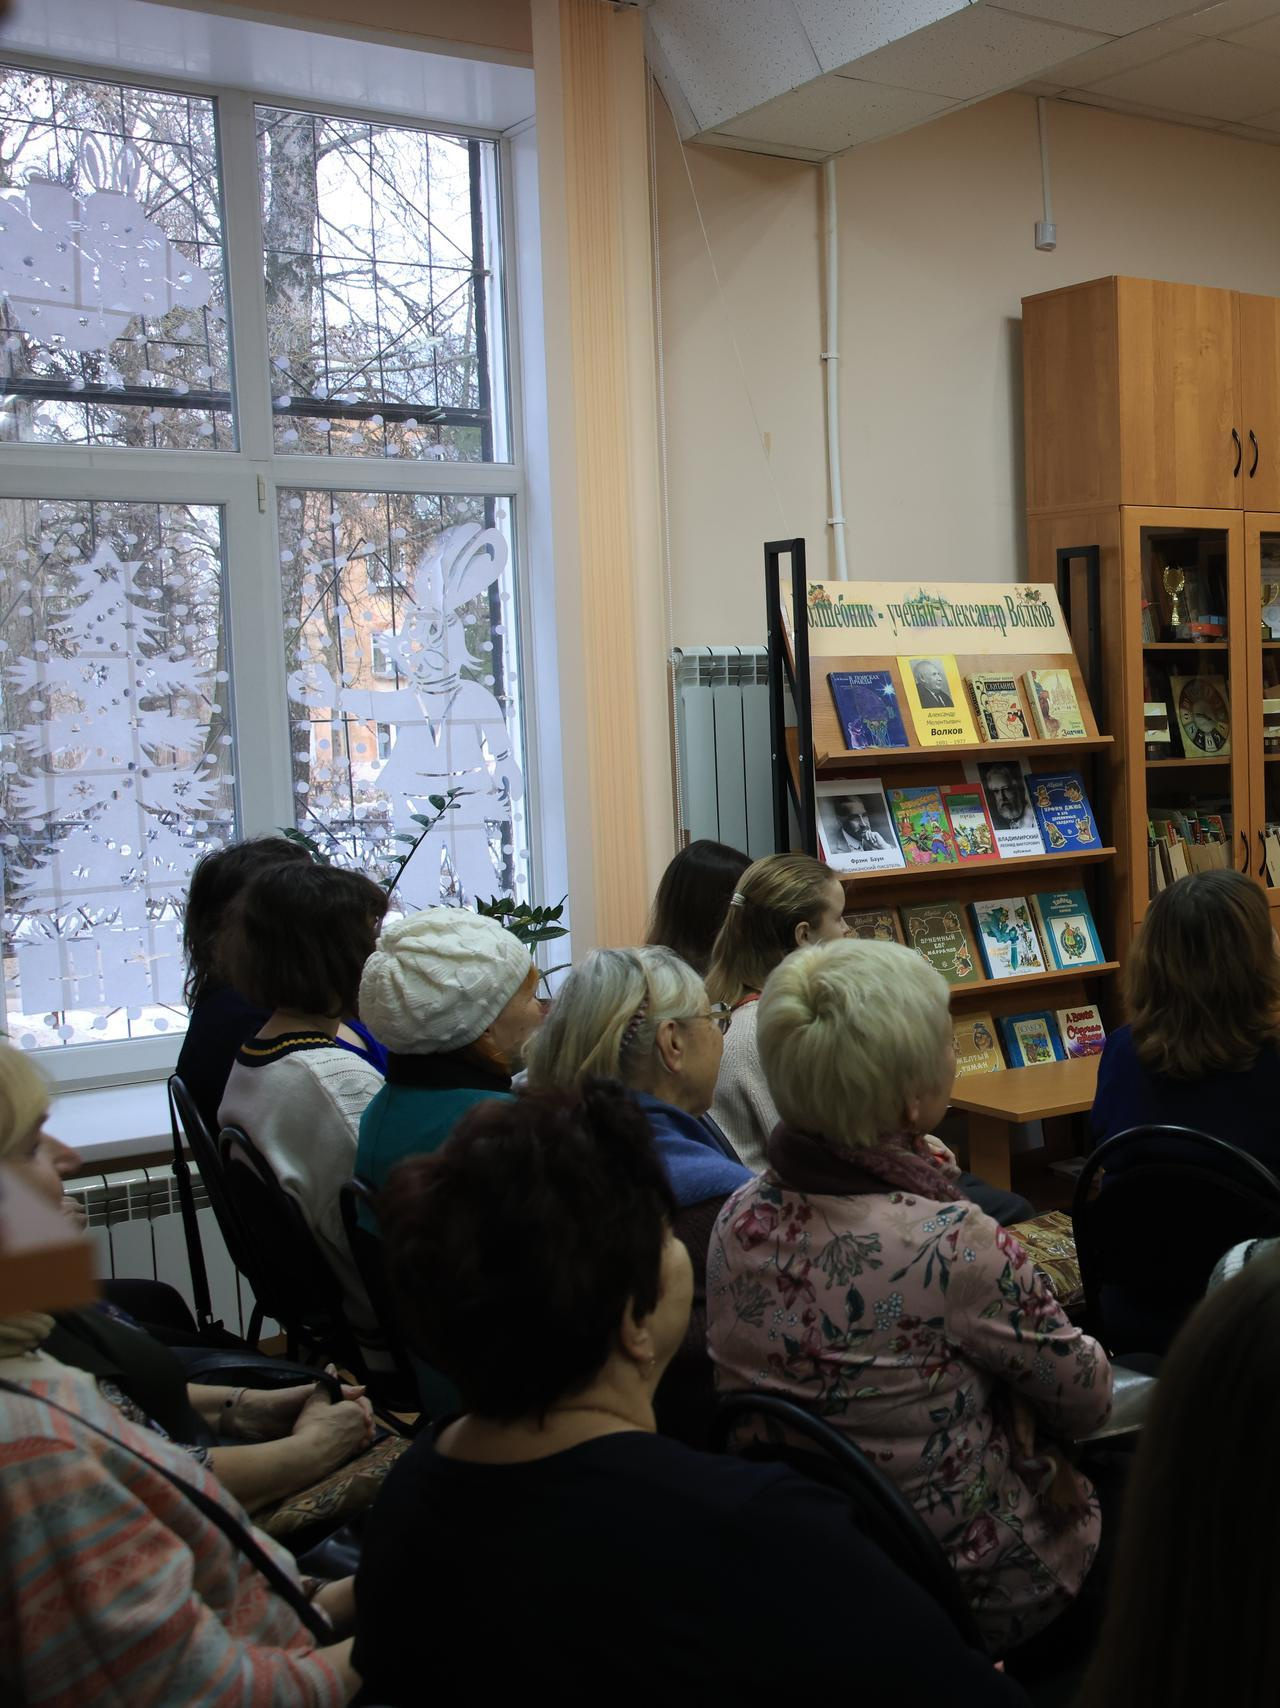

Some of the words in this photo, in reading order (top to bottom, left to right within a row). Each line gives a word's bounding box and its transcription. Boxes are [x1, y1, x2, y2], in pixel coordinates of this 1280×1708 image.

[808, 594, 877, 628] олшебник
[939, 595, 1007, 637] Александр
[1003, 594, 1056, 628] Волков
[931, 728, 963, 736] Волков
[998, 833, 1039, 842] ВЛАДИМИРСКИЙ
